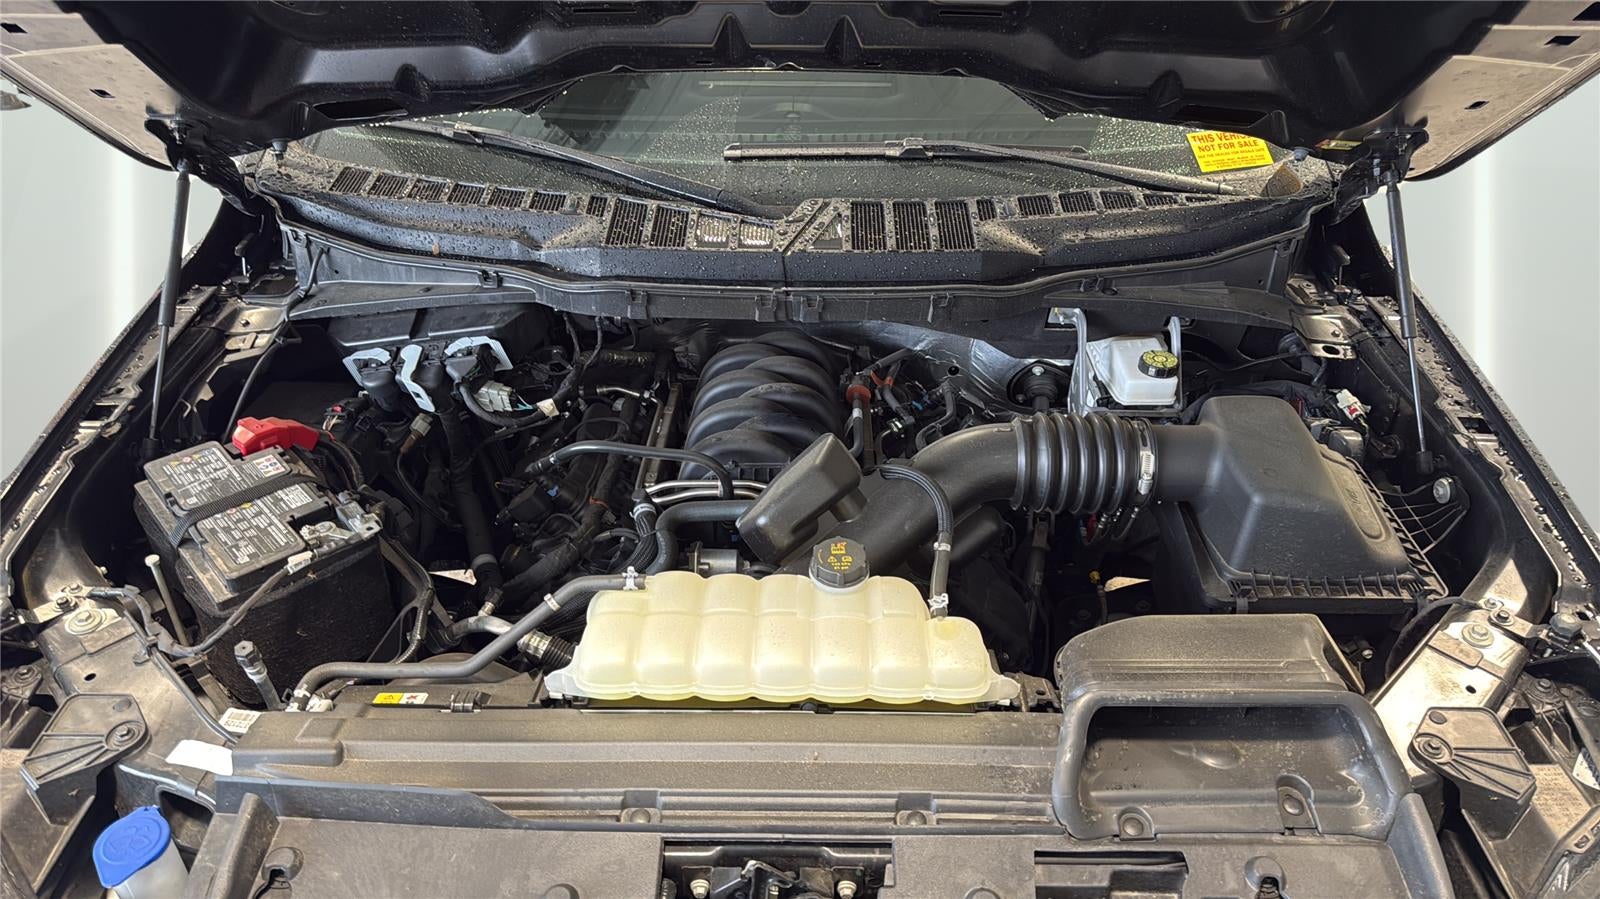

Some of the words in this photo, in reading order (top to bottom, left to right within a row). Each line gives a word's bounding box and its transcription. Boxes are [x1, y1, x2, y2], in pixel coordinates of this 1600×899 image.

[1191, 133, 1215, 144] THIS
[1216, 132, 1251, 141] VEHI
[1198, 144, 1215, 152] NOT
[1217, 142, 1235, 151] FOR
[1237, 139, 1259, 148] SALE
